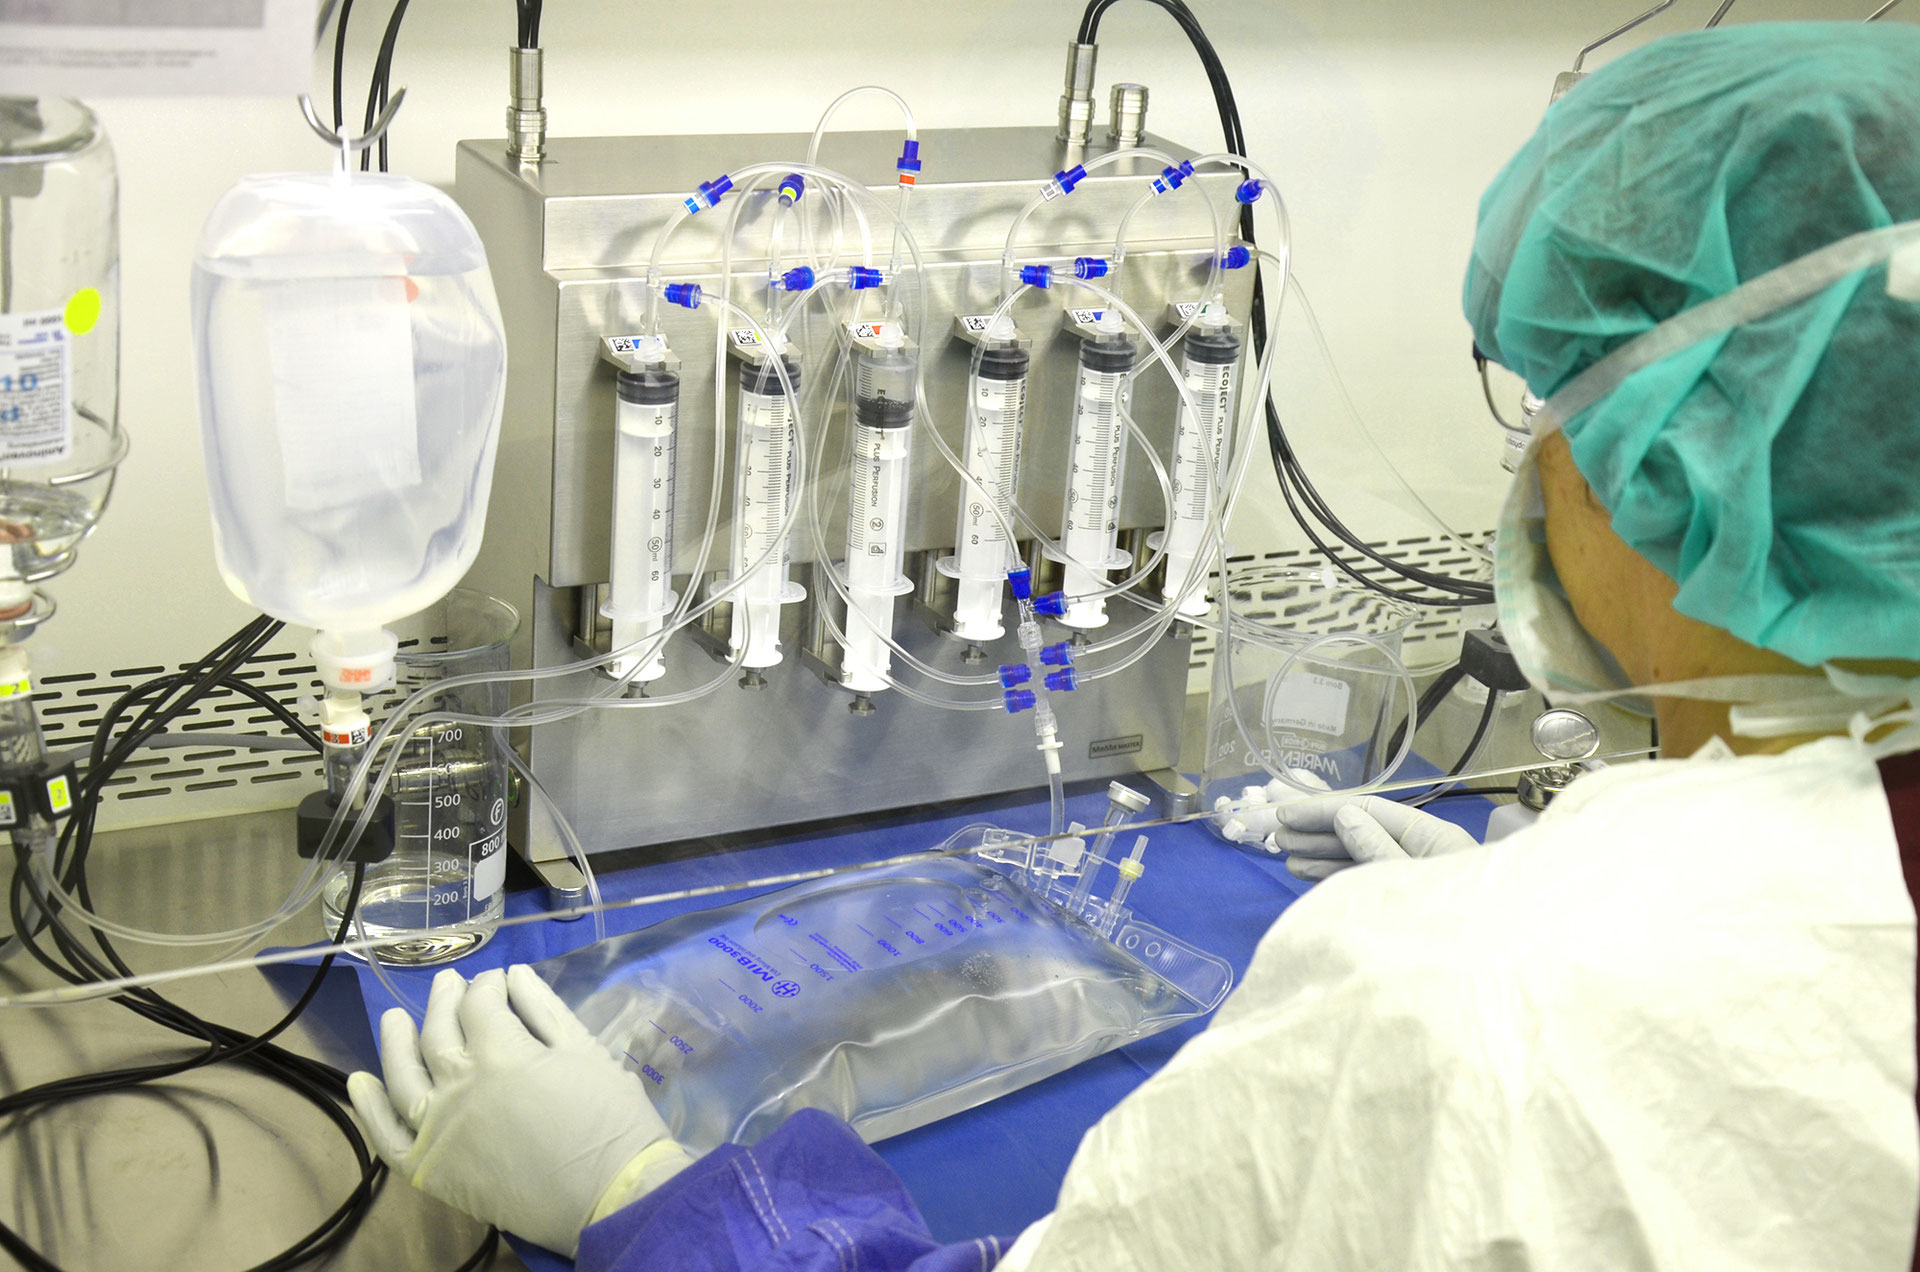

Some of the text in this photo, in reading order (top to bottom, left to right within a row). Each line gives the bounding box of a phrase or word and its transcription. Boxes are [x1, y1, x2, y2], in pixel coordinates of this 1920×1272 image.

[1080, 376, 1087, 386] 10
[981, 387, 989, 398] 10
[1077, 404, 1084, 415] 20
[654, 415, 663, 426] 10
[979, 416, 987, 427] 20
[1213, 365, 1231, 476] ECOJECT PLUS PERFUSIO
[1074, 434, 1081, 445] 30
[1113, 425, 1121, 443] PLUS
[653, 446, 663, 457] 20
[873, 443, 882, 462] PLUS
[1072, 463, 1079, 474] 40
[653, 478, 662, 489] 30
[871, 465, 881, 508] PERFUSION
[652, 509, 661, 520] 40
[1067, 520, 1074, 531] 60
[650, 539, 660, 551] 50
[970, 534, 979, 545] 60
[651, 570, 660, 582] 60
[437, 728, 463, 744] 700
[436, 760, 463, 776] 600
[434, 793, 461, 809] 500
[433, 826, 460, 841] 400
[481, 836, 500, 857] 800
[434, 859, 460, 874] 300
[433, 890, 459, 907] 200
[905, 930, 926, 945] 800
[877, 938, 902, 957] 1000
[707, 936, 775, 983] MIB3000
[809, 963, 834, 982] 1500
[738, 994, 764, 1014] 2000
[669, 1035, 695, 1055] 2500
[641, 1064, 665, 1085] 3000
